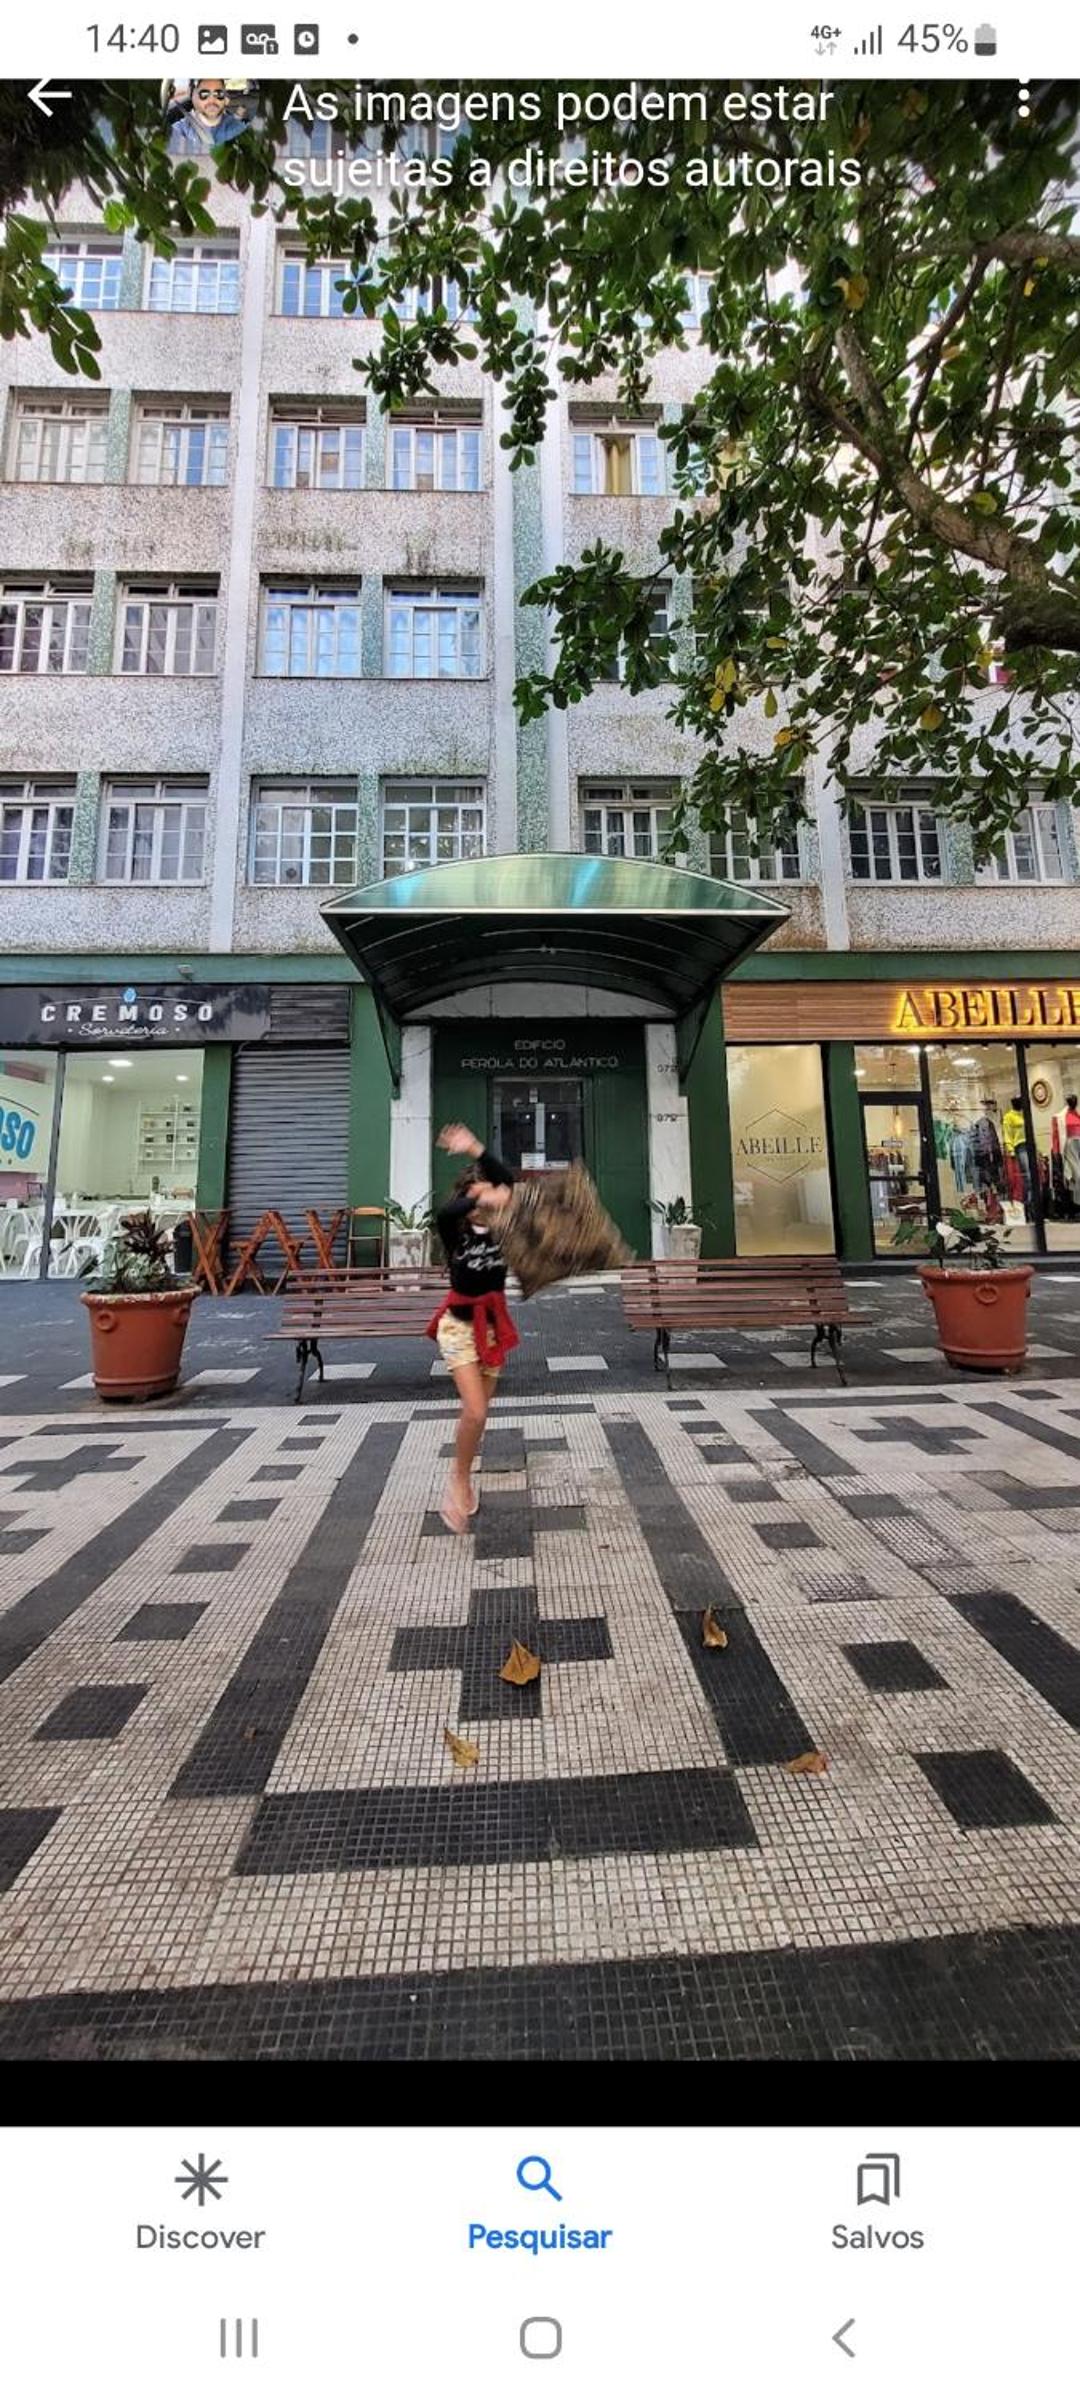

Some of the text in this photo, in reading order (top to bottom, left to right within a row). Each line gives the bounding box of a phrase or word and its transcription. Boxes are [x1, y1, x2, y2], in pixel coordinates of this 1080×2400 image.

[41, 1004, 213, 1022] CREMOSO
[0, 1107, 35, 1159] SO
[736, 1136, 824, 1155] ABEILLE
